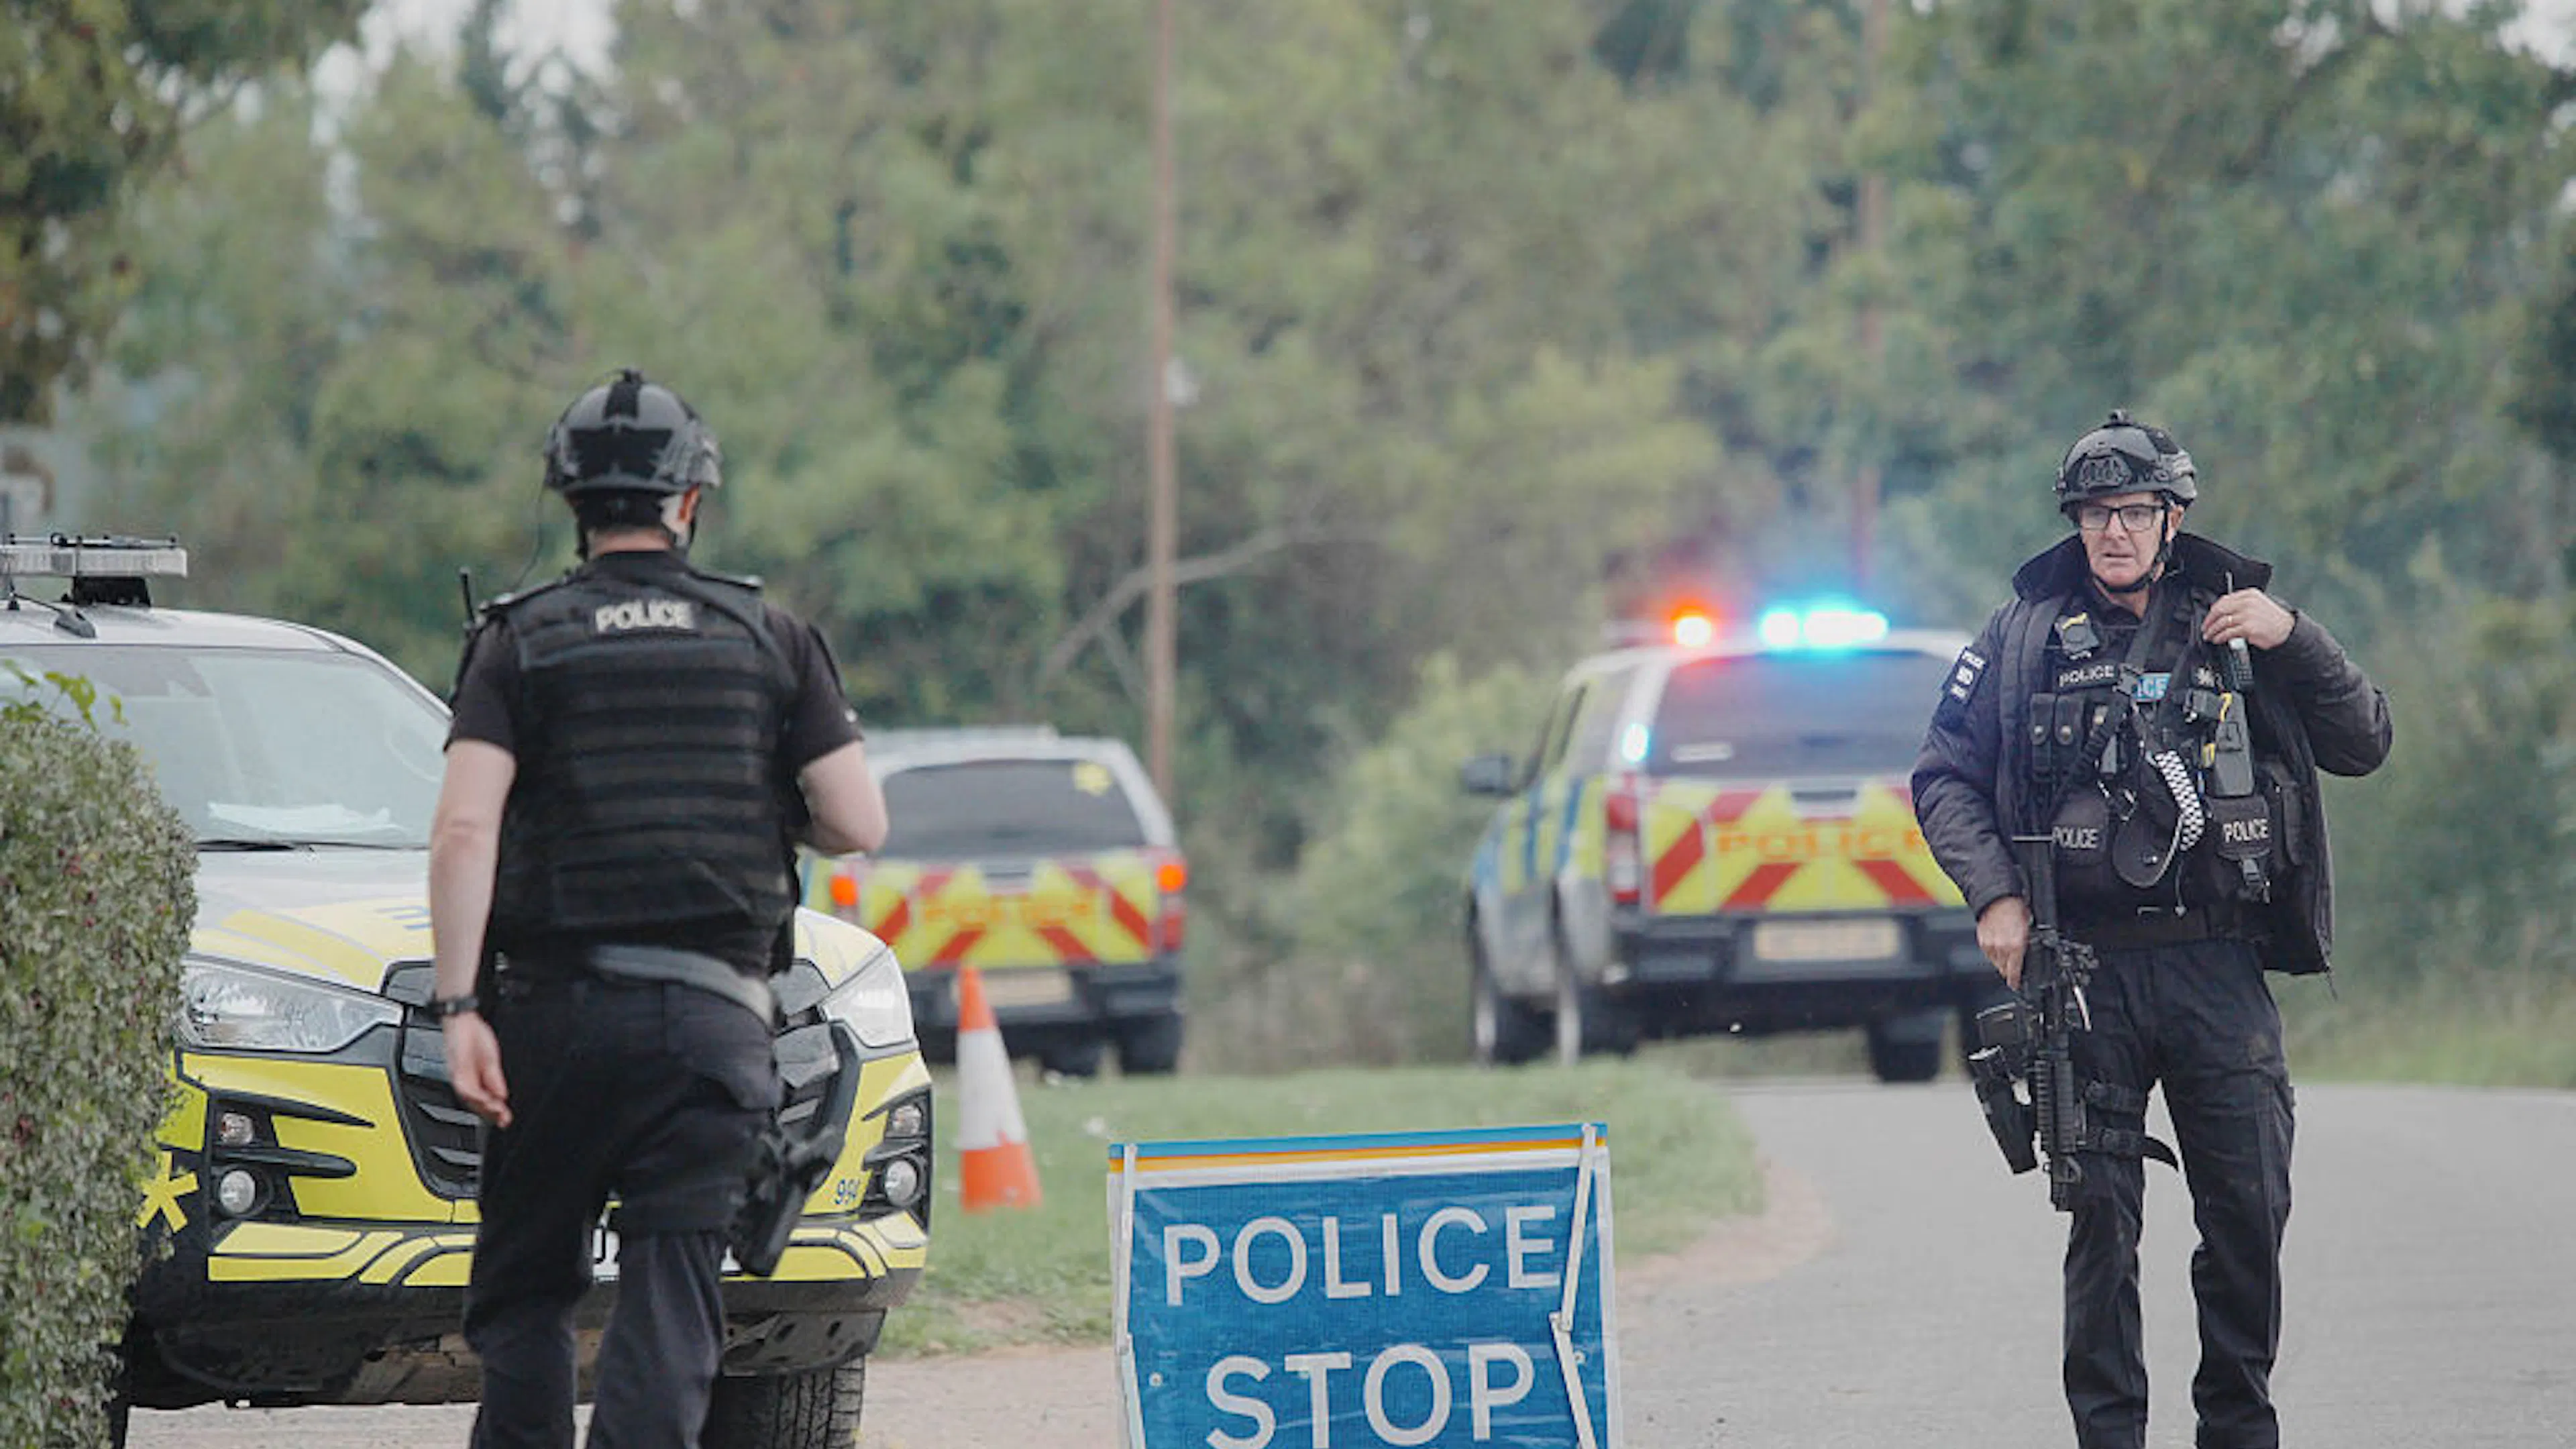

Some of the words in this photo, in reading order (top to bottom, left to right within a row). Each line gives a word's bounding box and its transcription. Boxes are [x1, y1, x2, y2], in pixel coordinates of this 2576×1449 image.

[596, 599, 694, 633] POLICE
[2059, 665, 2115, 687] POLICE
[2052, 826, 2099, 849] POLICE
[2222, 819, 2269, 843] POLICE
[1163, 1205, 1561, 1307] POLICE
[1205, 1342, 1535, 1449] STOP
